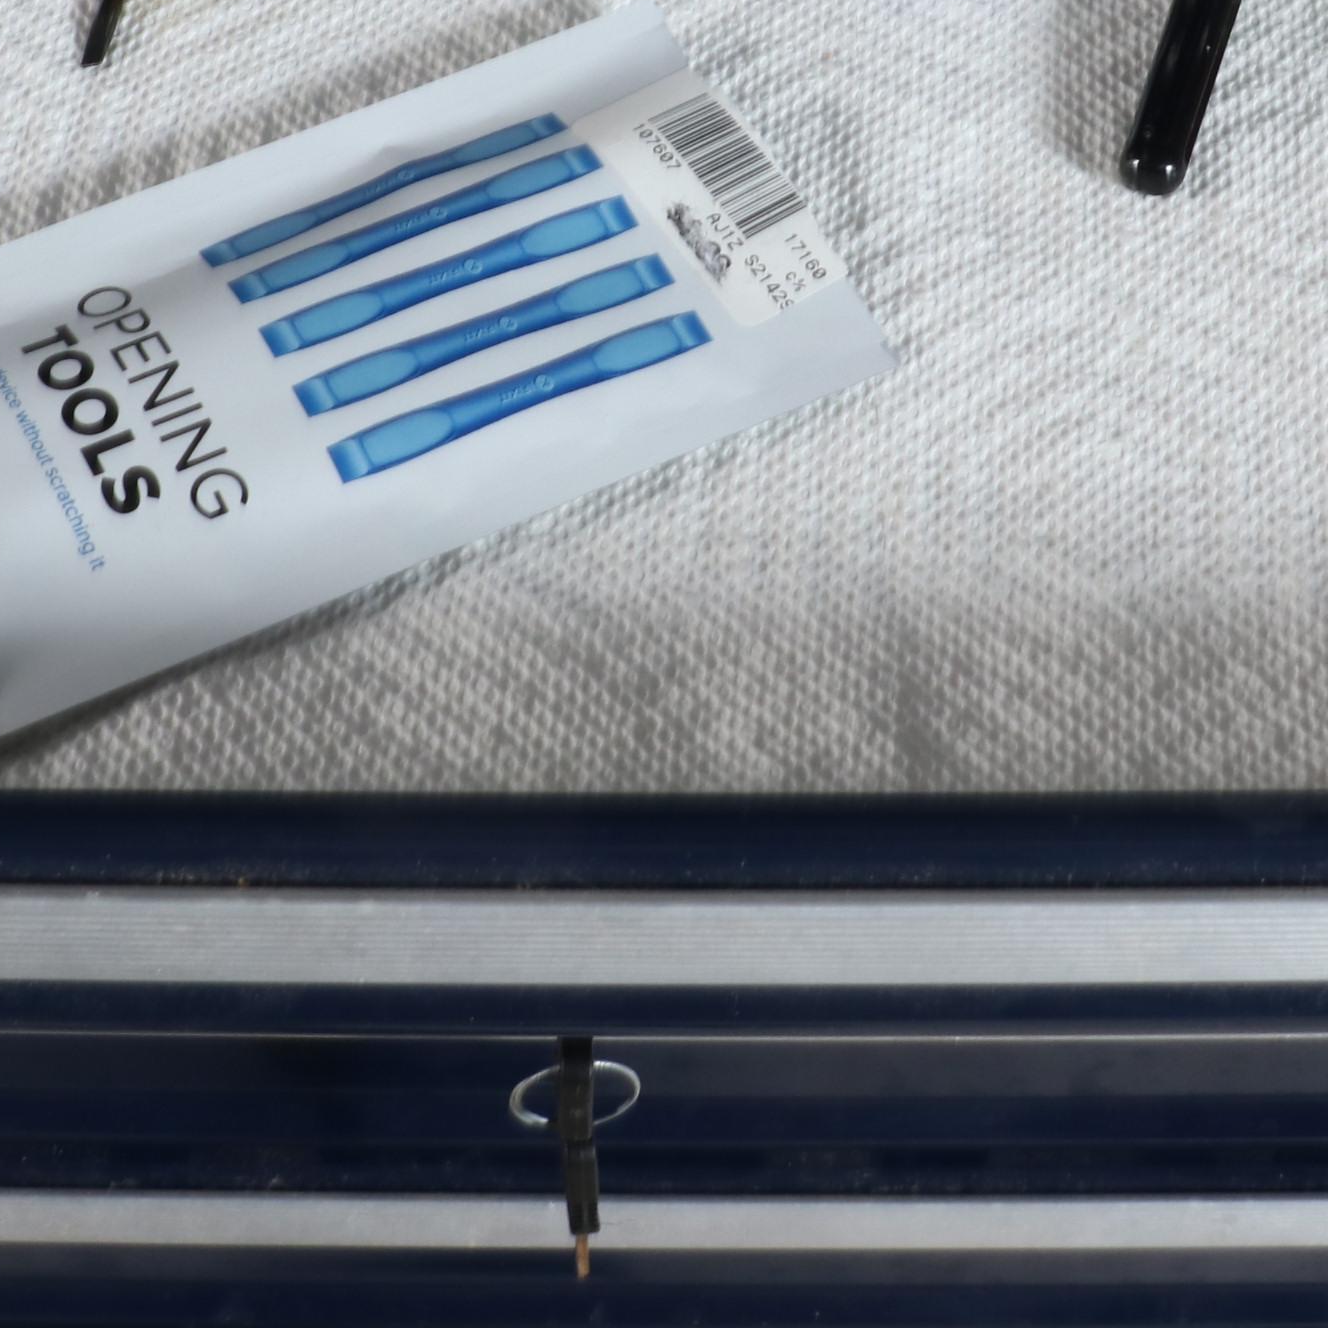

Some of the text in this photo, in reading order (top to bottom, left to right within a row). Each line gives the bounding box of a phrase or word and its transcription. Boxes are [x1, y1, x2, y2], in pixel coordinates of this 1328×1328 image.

[633, 123, 682, 170] 107607
[784, 233, 827, 280] 17160
[21, 324, 161, 514] TOOLS
[77, 286, 249, 519] OPENING
[15, 409, 54, 469] without
[44, 466, 96, 557] scratching
[88, 553, 107, 572] it
